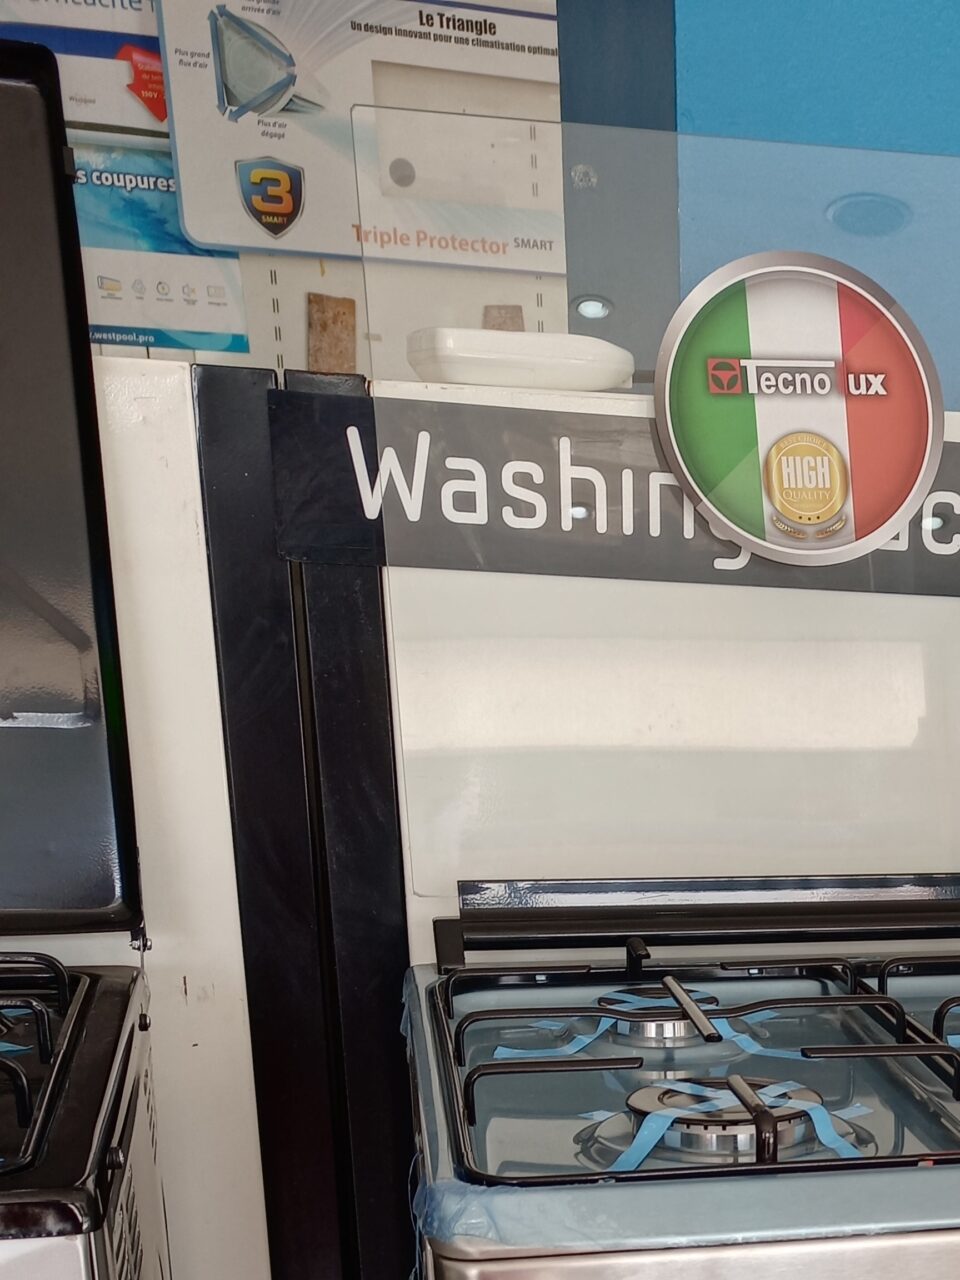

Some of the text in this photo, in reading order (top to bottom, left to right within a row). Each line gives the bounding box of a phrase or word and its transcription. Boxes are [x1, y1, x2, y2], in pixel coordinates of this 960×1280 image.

[418, 10, 497, 36] Le Triangle
[350, 20, 363, 31] Un
[363, 23, 393, 37] design
[394, 26, 432, 41] innovant
[433, 32, 452, 44] pour
[454, 36, 470, 46] une
[471, 36, 526, 53] climatisation
[174, 47, 211, 60] Plus grand
[257, 119, 271, 128] Plus
[260, 130, 286, 140] dégagé
[91, 170, 176, 192] coupures
[250, 168, 294, 214] 3
[260, 215, 287, 225] SMART
[351, 223, 554, 255] Triple Protector SMART
[781, 455, 831, 489] HIGH
[346, 424, 752, 570] Washin
[782, 489, 832, 501] QUALITY
